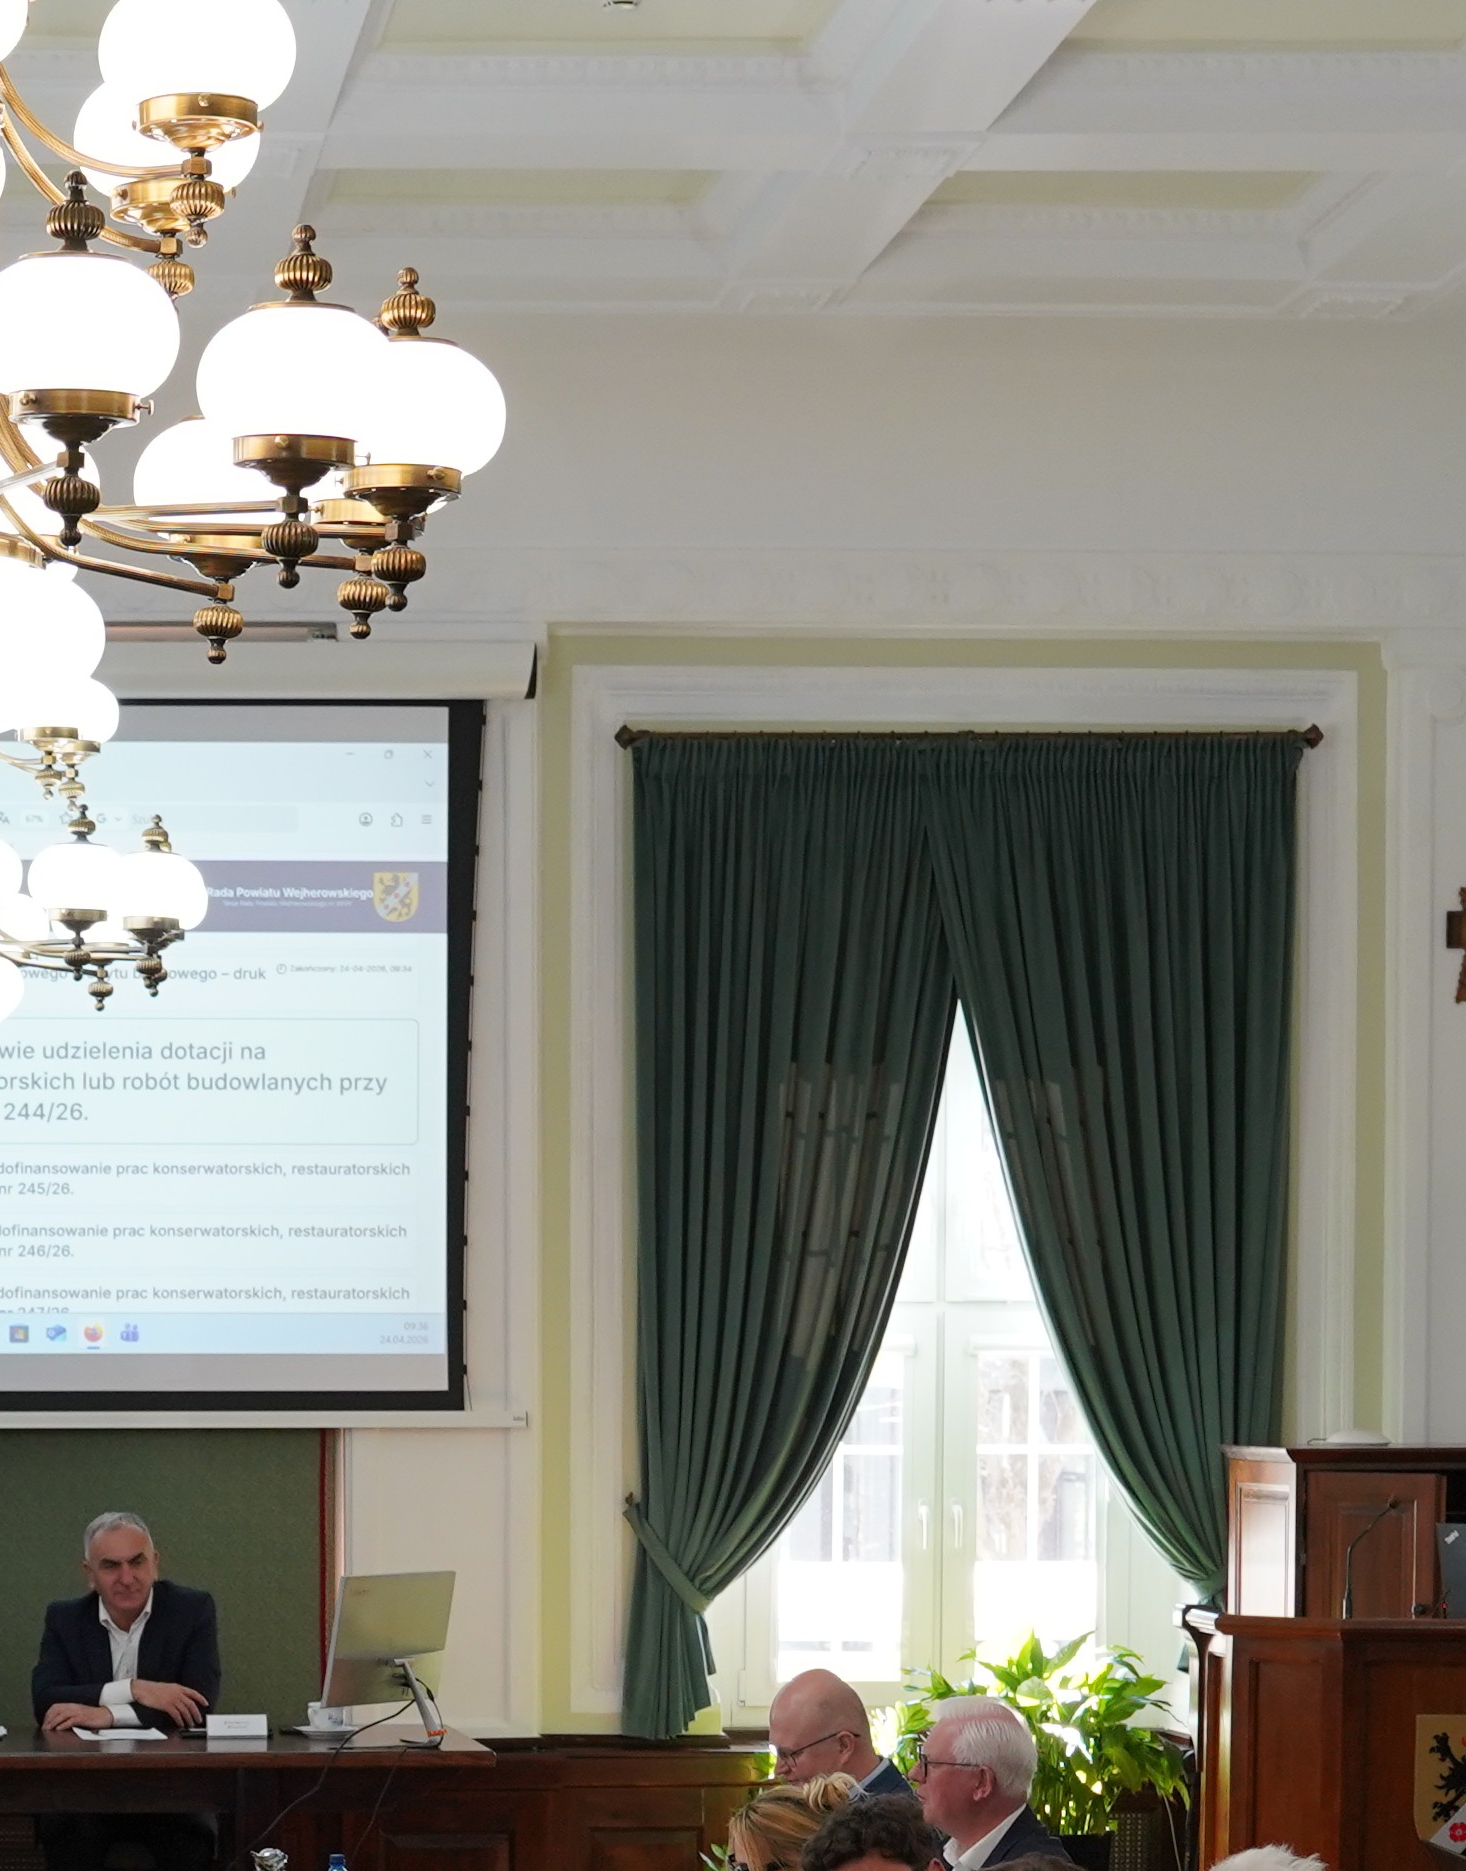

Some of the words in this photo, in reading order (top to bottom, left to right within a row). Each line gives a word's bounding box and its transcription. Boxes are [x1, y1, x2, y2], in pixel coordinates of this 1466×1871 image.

[208, 886, 234, 898] Rada
[236, 886, 281, 898] Powiatu
[282, 886, 374, 901] Wejherowskiego
[232, 966, 267, 981] druk
[42, 1040, 153, 1061] udzielenia
[160, 1040, 233, 1065] dotacji
[240, 1045, 266, 1061] na
[82, 1071, 116, 1091] lub
[122, 1071, 181, 1091] robót
[186, 1071, 333, 1096] budowlanych
[339, 1076, 388, 1097] przy
[3, 1101, 89, 1124] 244/26.
[115, 1164, 149, 1179] prac
[152, 1161, 287, 1178] konserwatorskich,
[291, 1162, 411, 1176] restauratorskich
[17, 1181, 74, 1197] 245/26.
[112, 1226, 146, 1241] prac
[149, 1223, 284, 1241] konserwatorskich,
[287, 1224, 408, 1238] restauratorskich
[17, 1243, 75, 1259] 246/26.
[115, 1288, 149, 1303] prac
[152, 1285, 287, 1302] konserwatorskich,
[291, 1286, 410, 1300] restauratorskich
